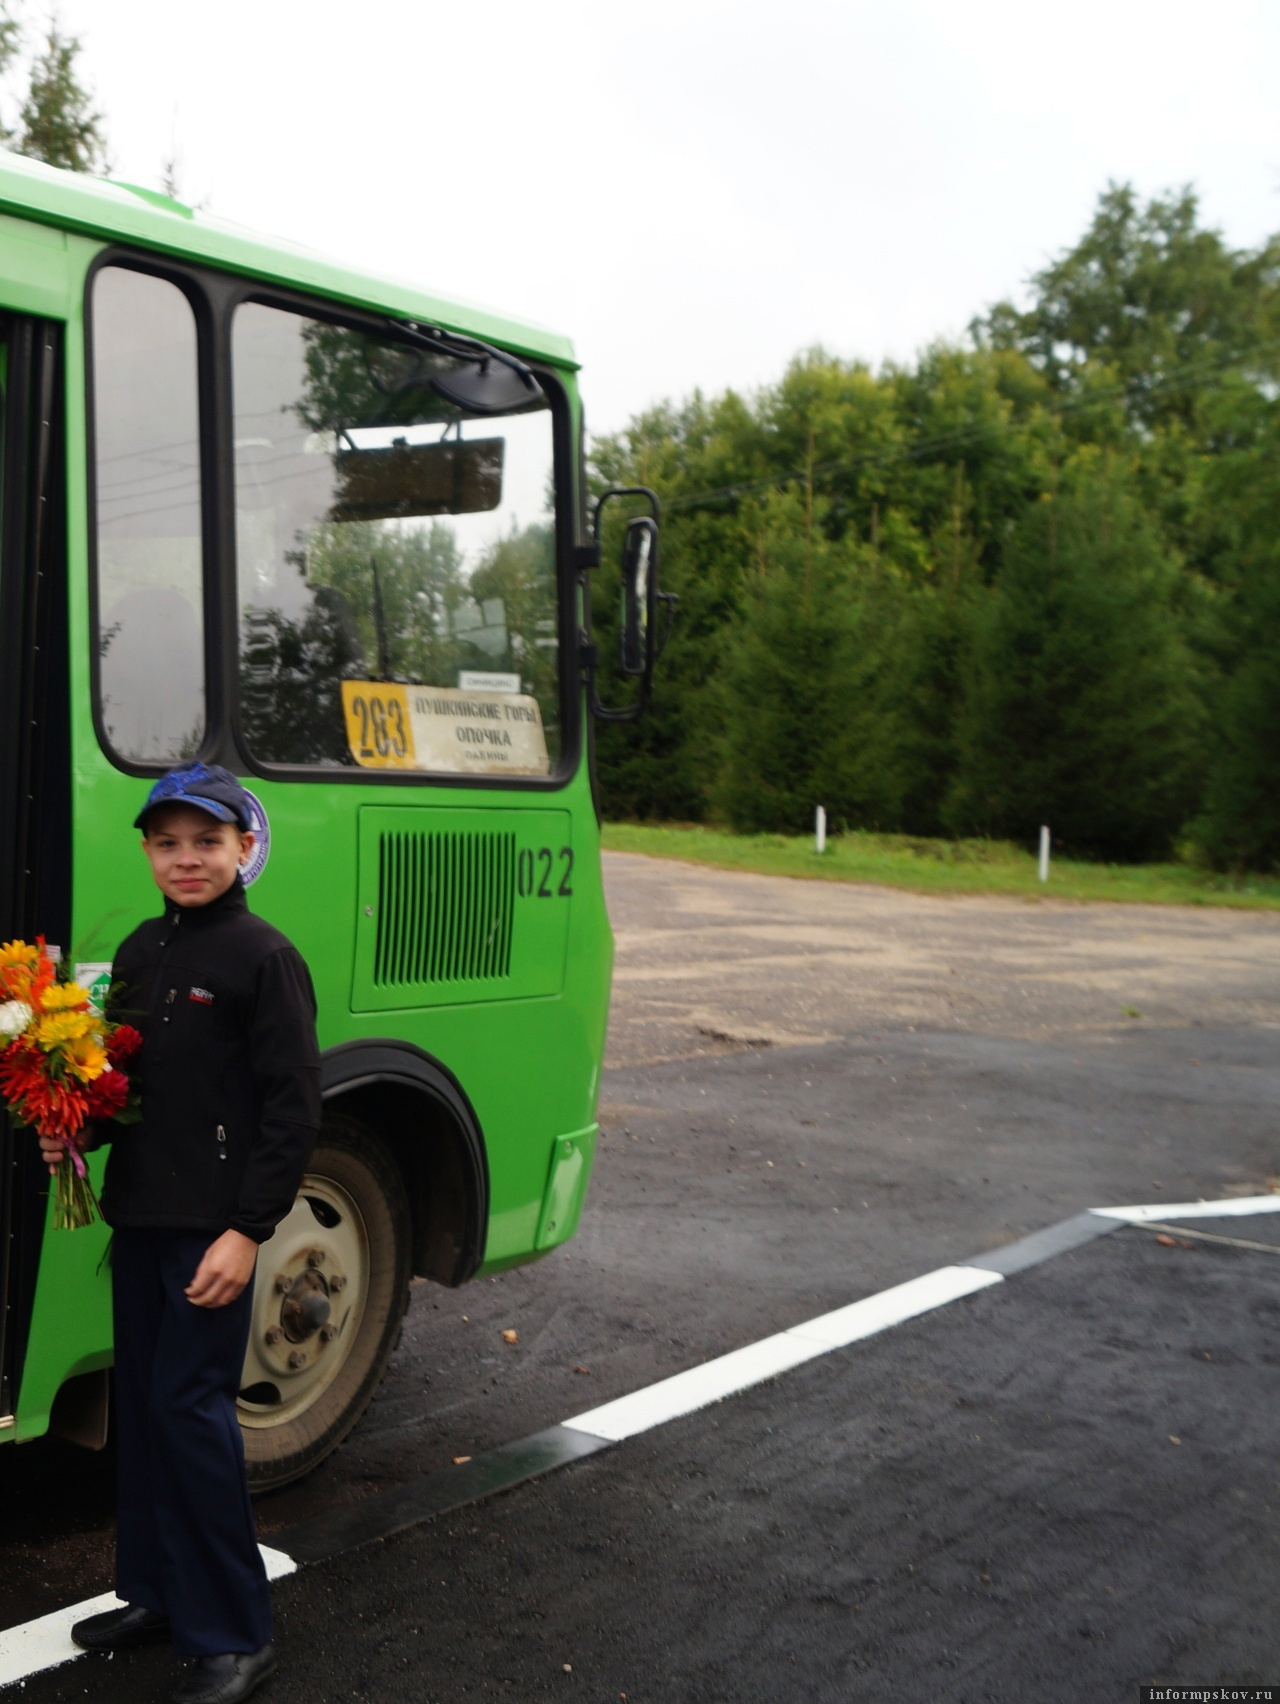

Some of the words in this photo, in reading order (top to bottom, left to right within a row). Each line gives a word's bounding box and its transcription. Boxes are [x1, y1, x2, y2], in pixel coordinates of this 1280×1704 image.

[353, 696, 407, 757] 283
[415, 698, 501, 720] ПУШКИНСКИЕ
[504, 704, 536, 723] ГОРЫ
[456, 726, 512, 746] ОПОЧКА
[518, 846, 574, 898] 022
